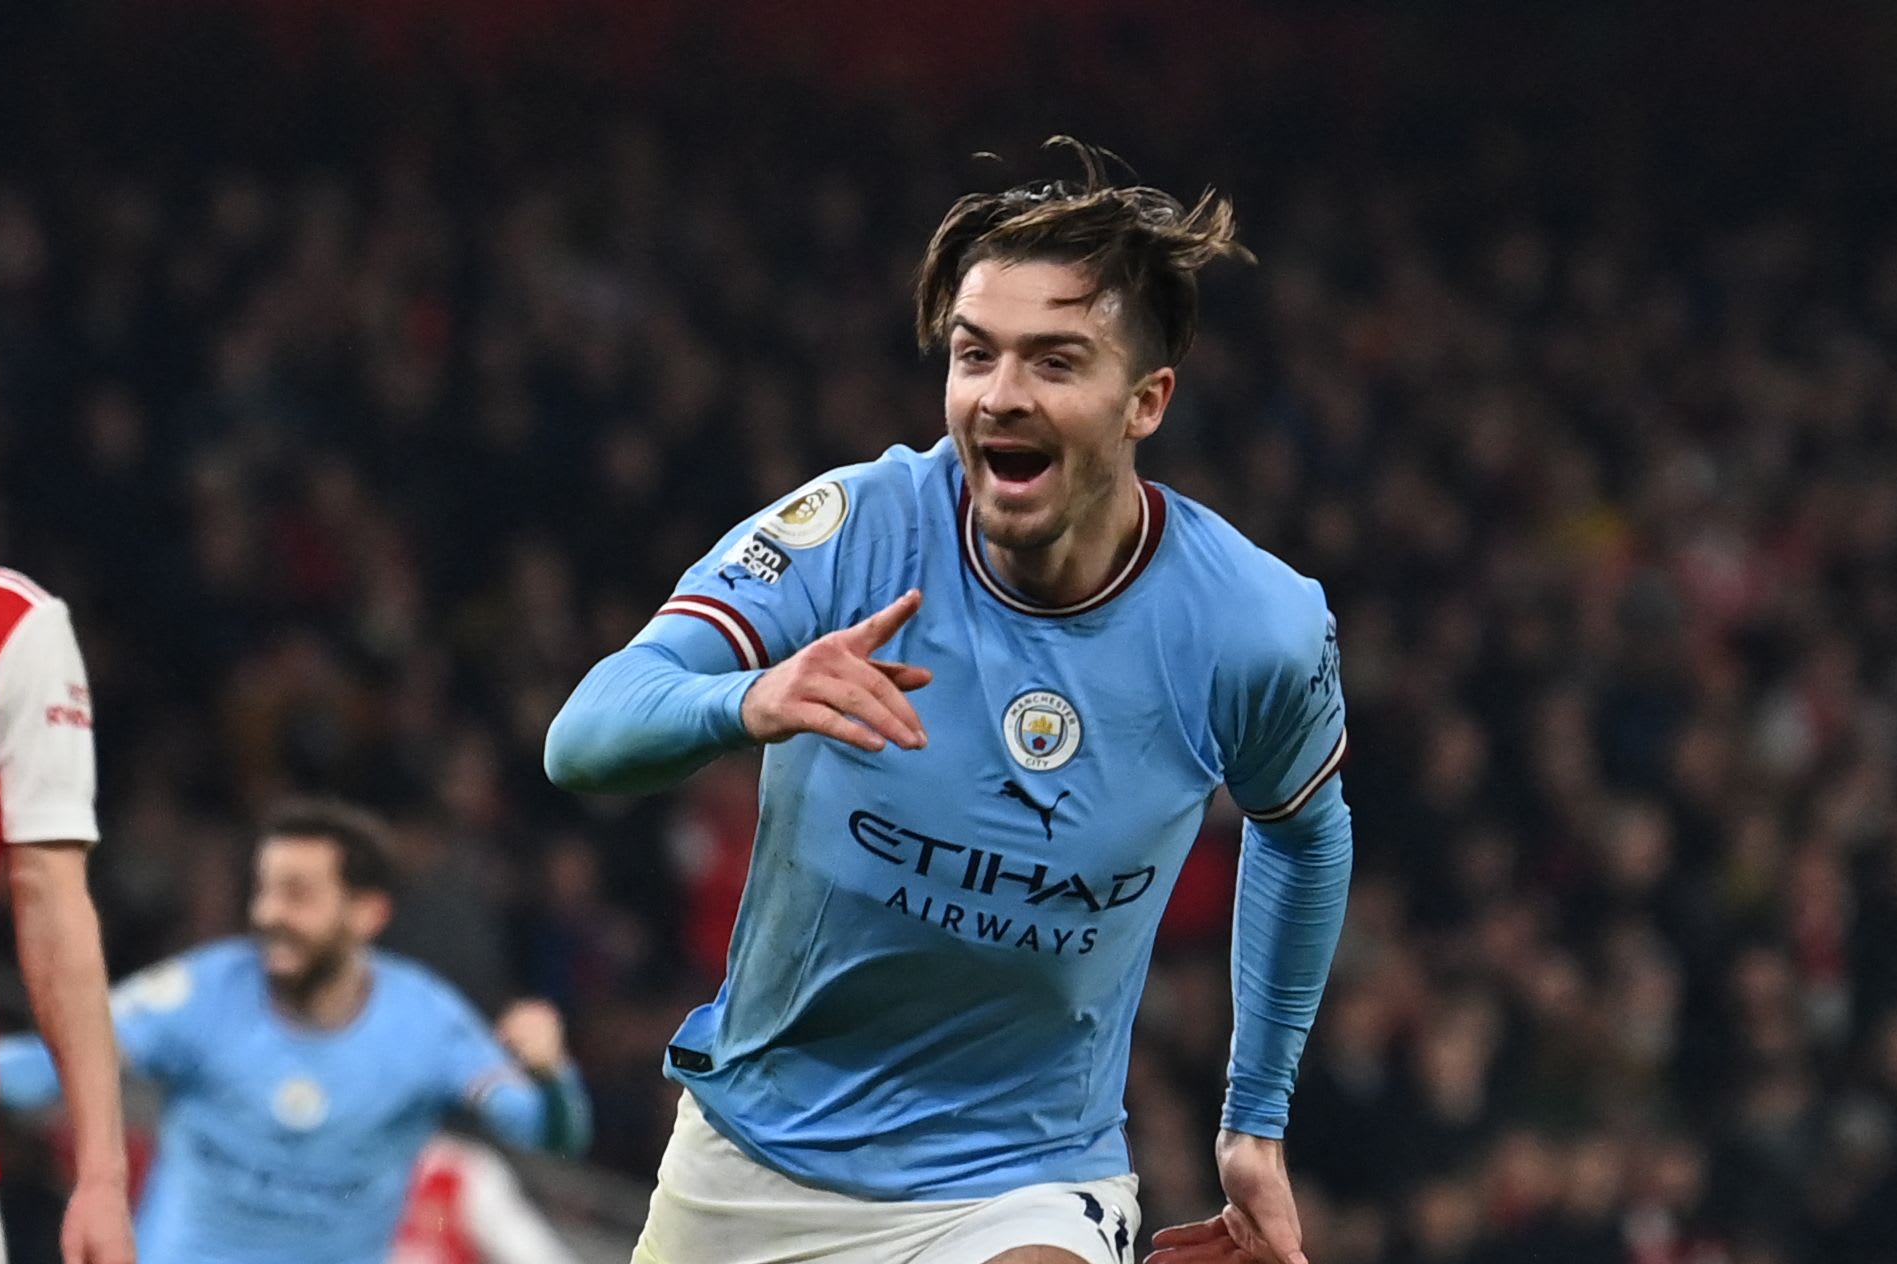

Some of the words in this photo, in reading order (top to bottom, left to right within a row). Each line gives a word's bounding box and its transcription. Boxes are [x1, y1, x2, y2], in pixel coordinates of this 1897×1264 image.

[1010, 694, 1076, 726] MANCHESTER
[1025, 758, 1050, 768] CITY
[849, 810, 1155, 912] ETIHAD
[886, 886, 1098, 955] AIRWAYS
